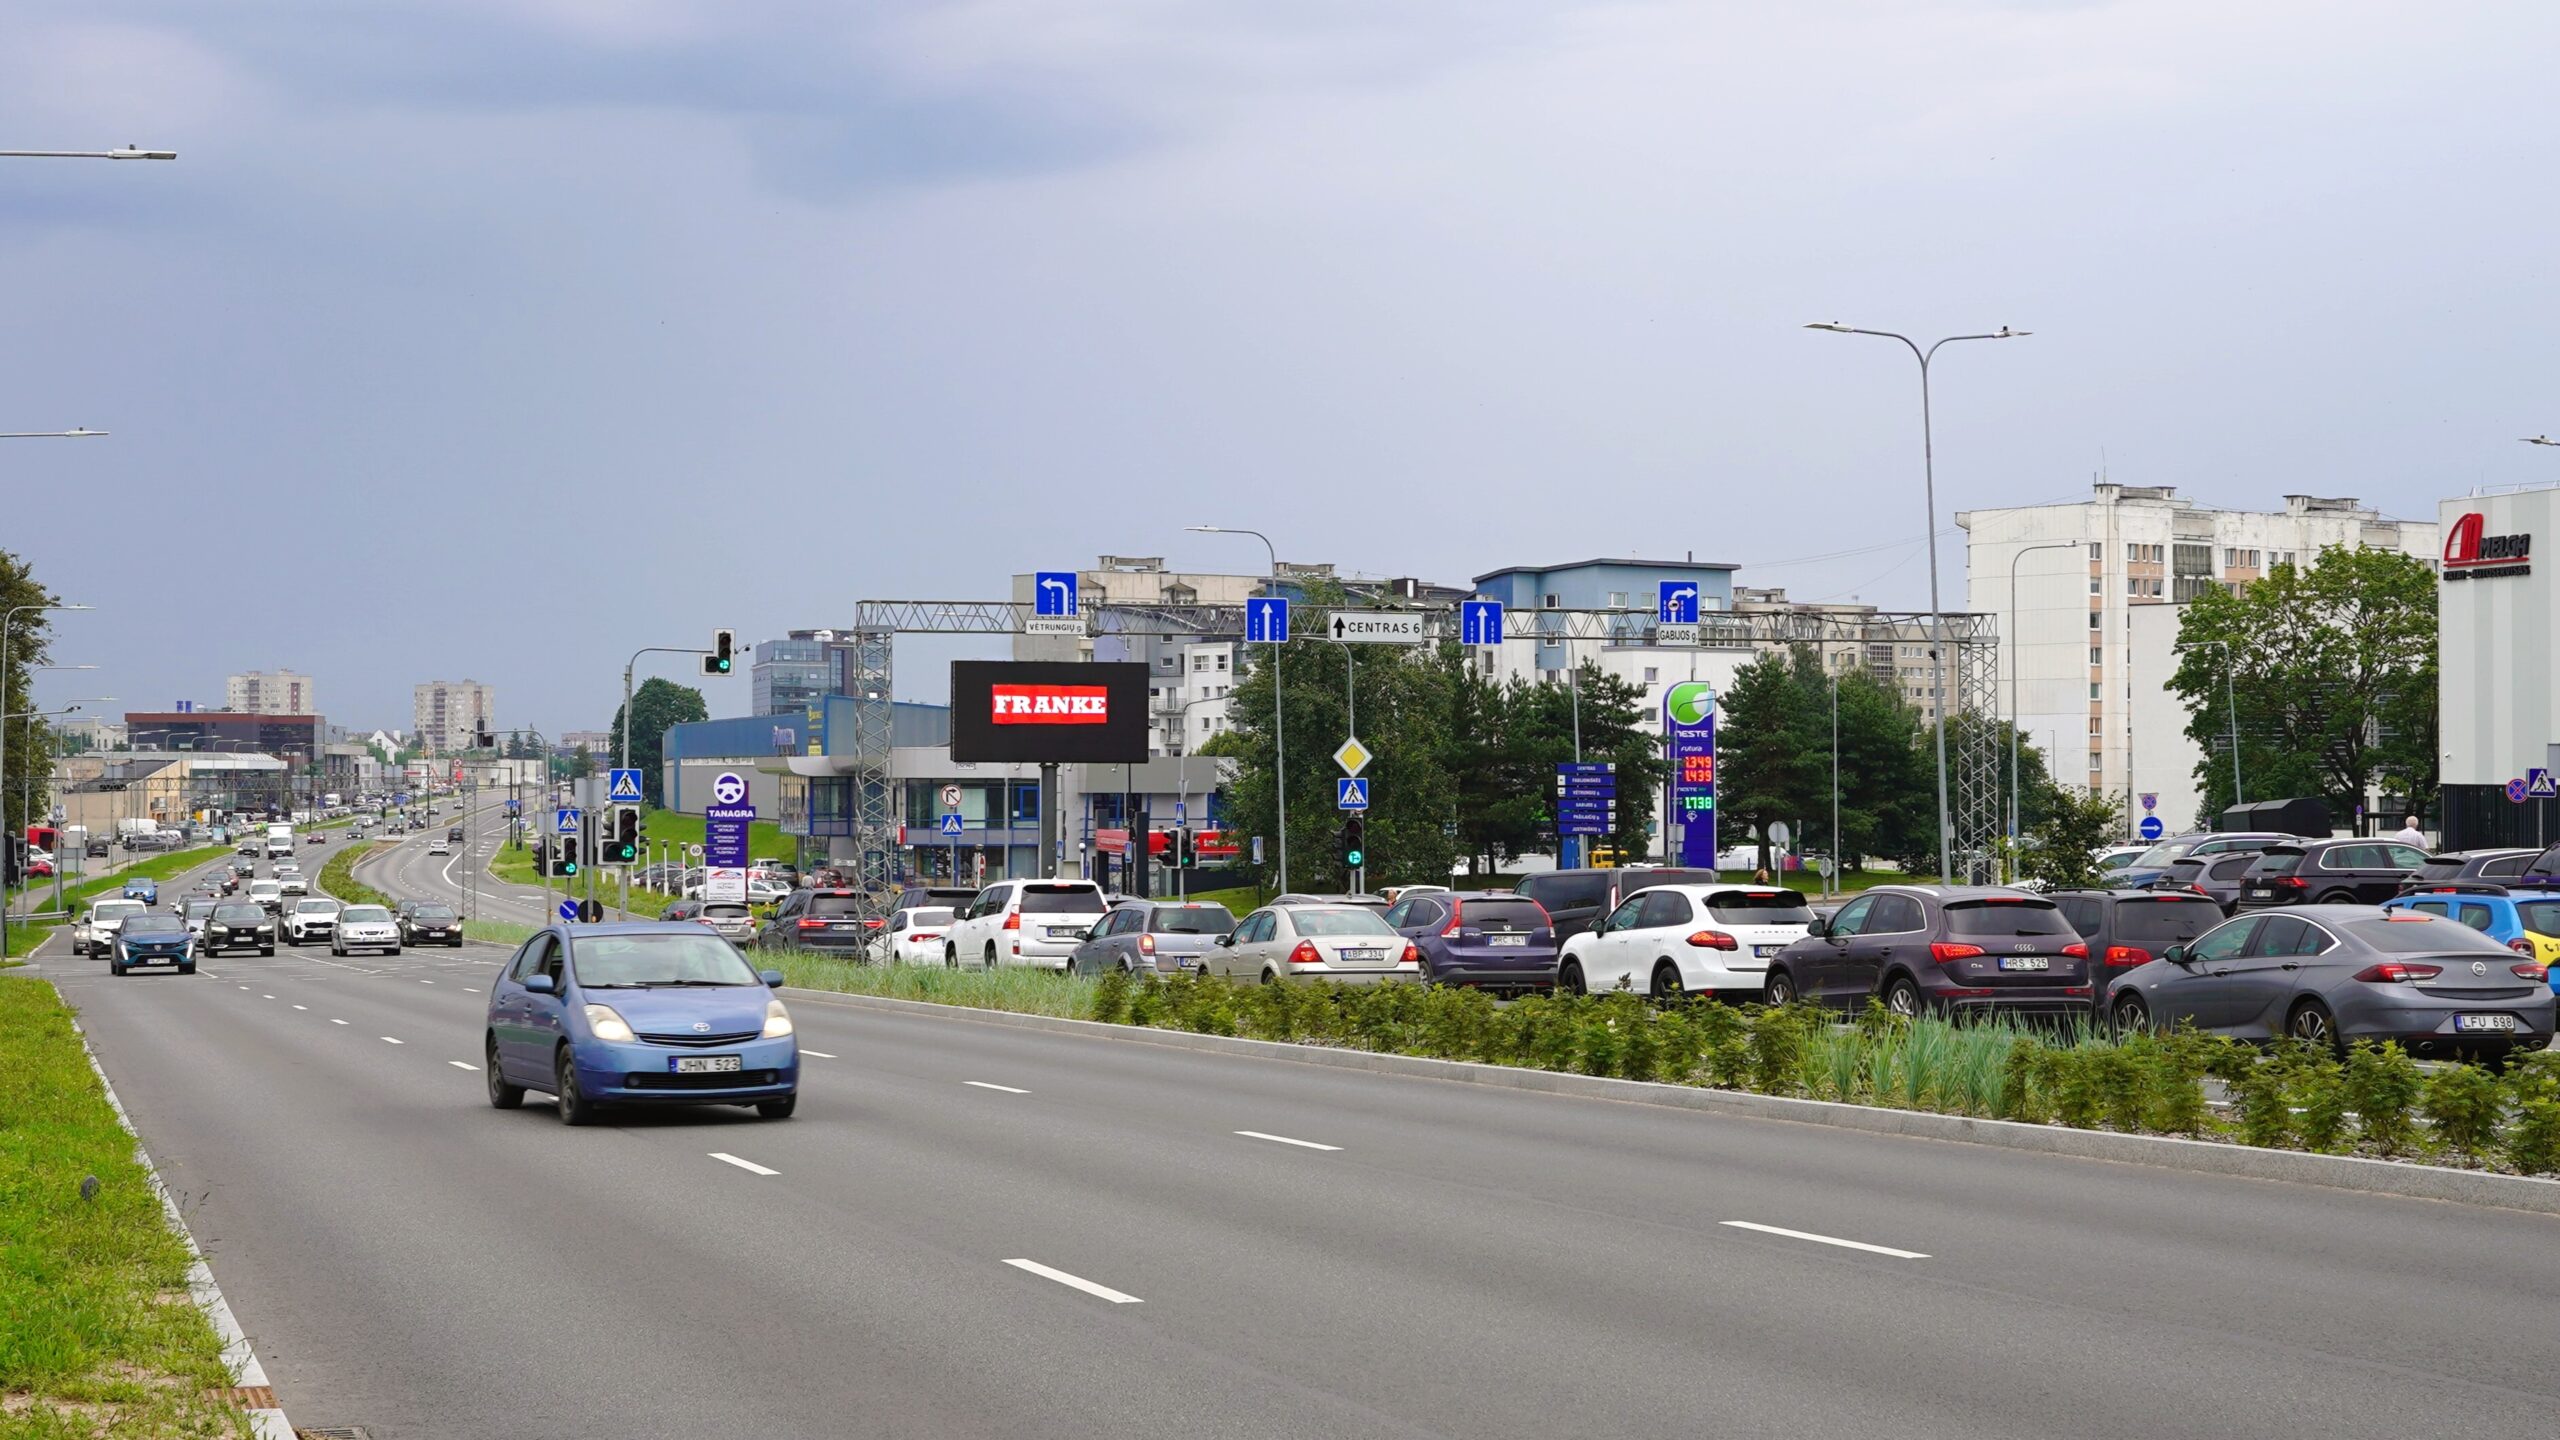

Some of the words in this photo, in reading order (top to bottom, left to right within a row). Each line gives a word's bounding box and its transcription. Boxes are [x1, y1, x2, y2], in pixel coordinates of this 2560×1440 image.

[2480, 534, 2530, 559] MELGA
[1029, 622, 1075, 632] VĖTRUNGIŲ
[1348, 622, 1409, 633] CENTRAS
[1413, 623, 1420, 634] 6
[1660, 630, 1690, 640] GABIJOS
[994, 695, 1106, 714] FRANKE
[2006, 959, 2025, 967] HRS
[2031, 958, 2047, 967] 525
[2463, 1017, 2486, 1027] LFU
[2493, 1017, 2513, 1027] 698
[680, 1060, 707, 1071] JHN
[715, 1059, 739, 1070] 523
